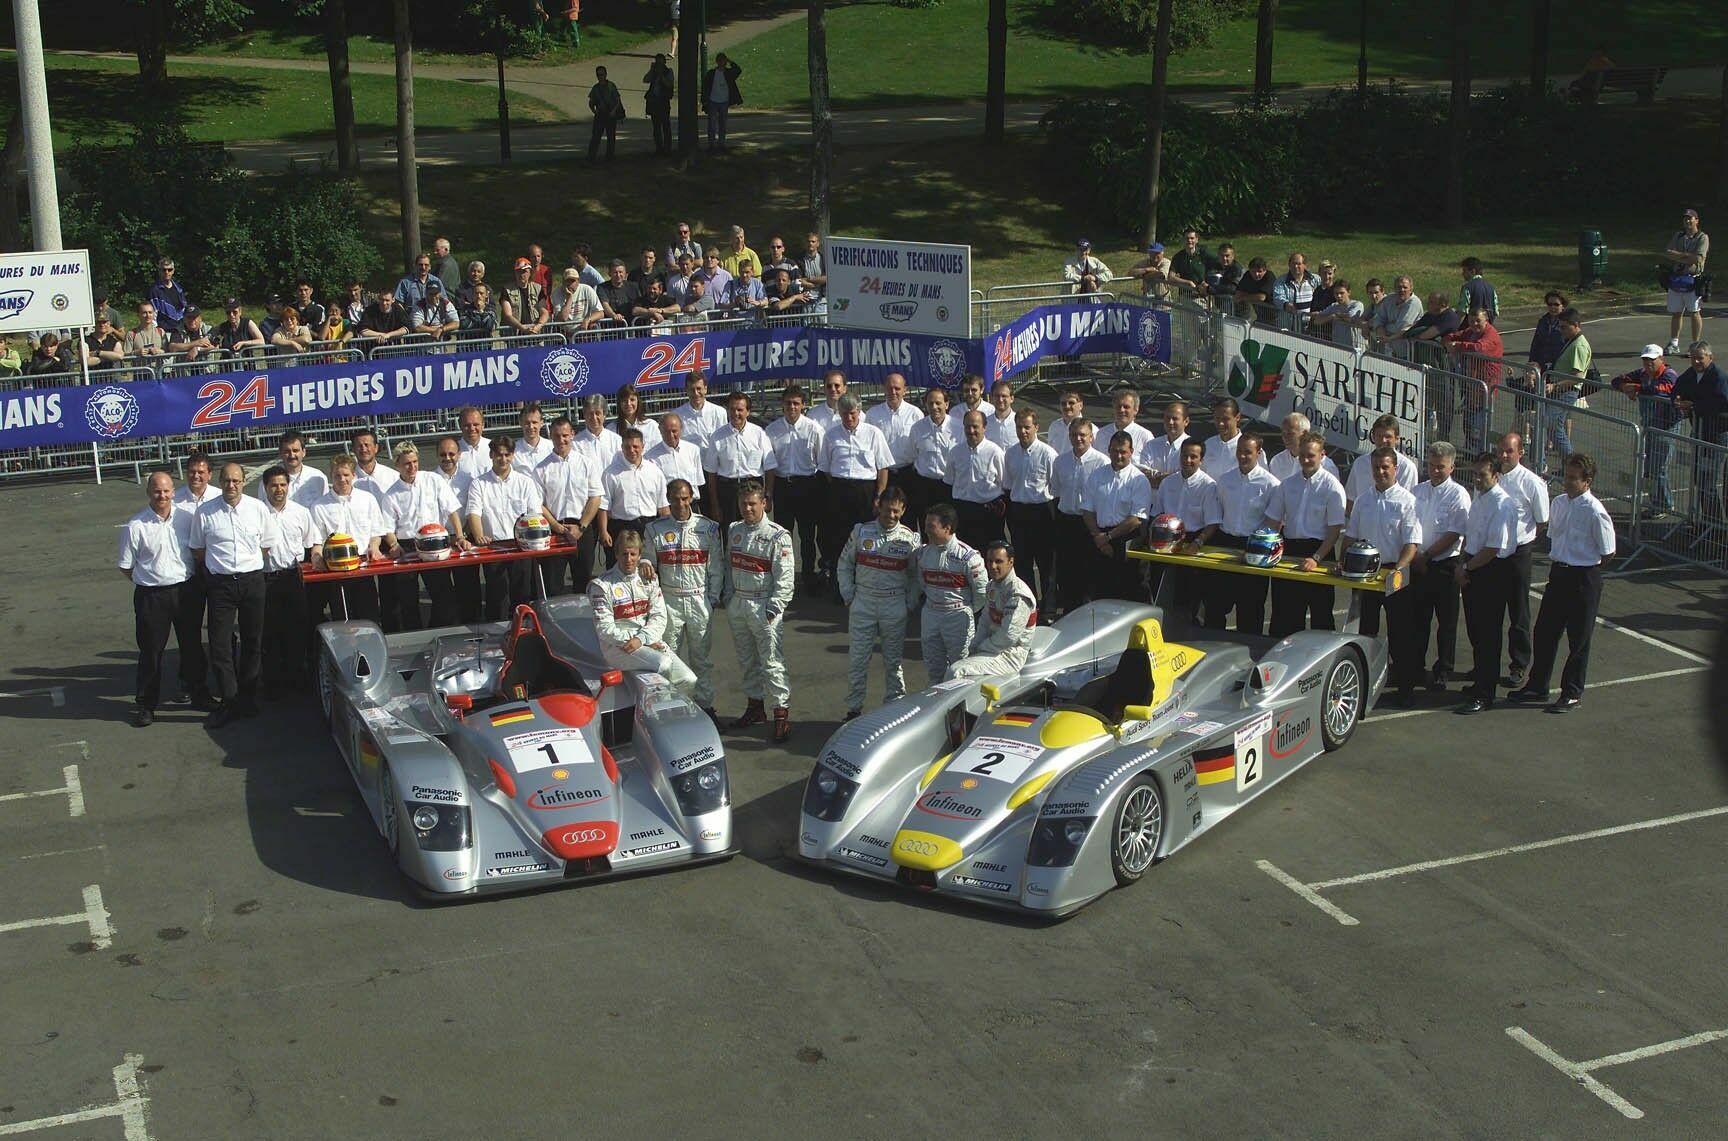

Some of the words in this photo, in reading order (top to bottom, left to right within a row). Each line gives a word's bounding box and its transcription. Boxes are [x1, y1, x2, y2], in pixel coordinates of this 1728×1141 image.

[30, 265, 45, 276] DU
[50, 263, 81, 275] MANS
[831, 246, 899, 269] VERIFICATIONS
[906, 251, 963, 274] TECHNIQUES
[859, 276, 881, 294] 24
[881, 281, 906, 297] HEURES
[907, 282, 919, 298] DU
[920, 284, 942, 300] MANS
[881, 303, 890, 315] LE
[891, 305, 914, 317] MANS
[993, 328, 1013, 381] 24
[1012, 320, 1040, 366] HEURES
[1070, 309, 1131, 339] MANS
[634, 337, 711, 389] 24
[716, 339, 809, 376] HEURES
[817, 338, 844, 366] DU
[852, 338, 912, 366] MANS
[190, 374, 276, 430] 24
[282, 372, 385, 415] HEURES
[395, 365, 433, 397] DU
[443, 353, 520, 391] MANS
[1293, 351, 1419, 424] SARTHE
[0, 393, 62, 430] ANS
[1292, 395, 1349, 436] Conseil
[1355, 415, 1419, 458] Gral
[537, 743, 560, 764] 1
[669, 745, 714, 768] Panasonic
[677, 761, 692, 770] Car
[693, 752, 715, 765] Audio
[827, 750, 862, 774] Panasonic
[970, 752, 1005, 775] 2
[825, 757, 837, 767] Car
[836, 764, 854, 777] Audio
[1244, 748, 1257, 785] 2
[411, 785, 463, 798] Panasonic
[415, 792, 432, 800] Car
[433, 793, 459, 802] Audio
[630, 828, 665, 840] MAHLE
[859, 834, 890, 849] MAHLE
[495, 850, 530, 860] MAHLE
[634, 842, 678, 855] MICHELIN
[848, 850, 887, 865] MICHELIN
[500, 863, 547, 874] MICHELIN
[973, 861, 1008, 872] MAHLE
[965, 878, 1009, 891] MICHELIN
